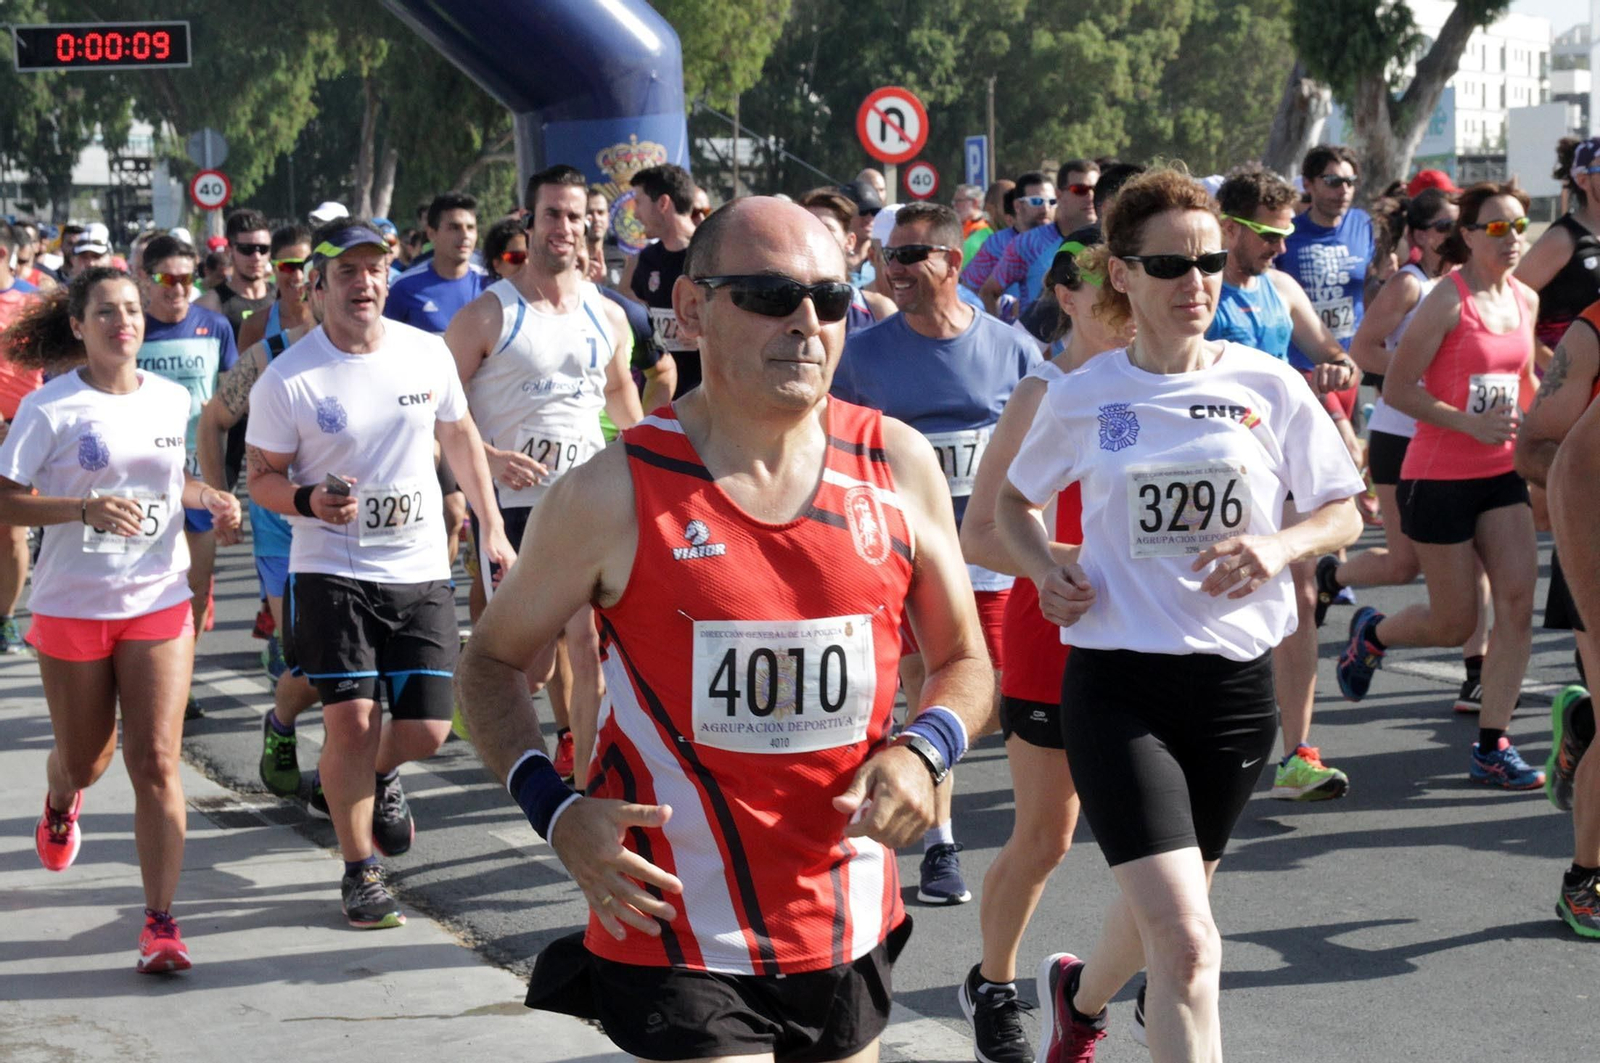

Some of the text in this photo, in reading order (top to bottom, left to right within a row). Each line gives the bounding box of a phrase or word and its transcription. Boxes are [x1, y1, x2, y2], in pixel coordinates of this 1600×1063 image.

[56, 31, 170, 62] 0:00:09
[199, 182, 222, 196] 40
[912, 174, 932, 186] 40
[1316, 305, 1351, 329] 052
[1188, 404, 1247, 420] CNP
[520, 436, 578, 471] 4219
[365, 491, 424, 529] 3292
[1139, 479, 1242, 533] 3296
[708, 644, 848, 718] 4010
[787, 716, 854, 732] DEPORTIVA
[769, 737, 790, 748] 4010
